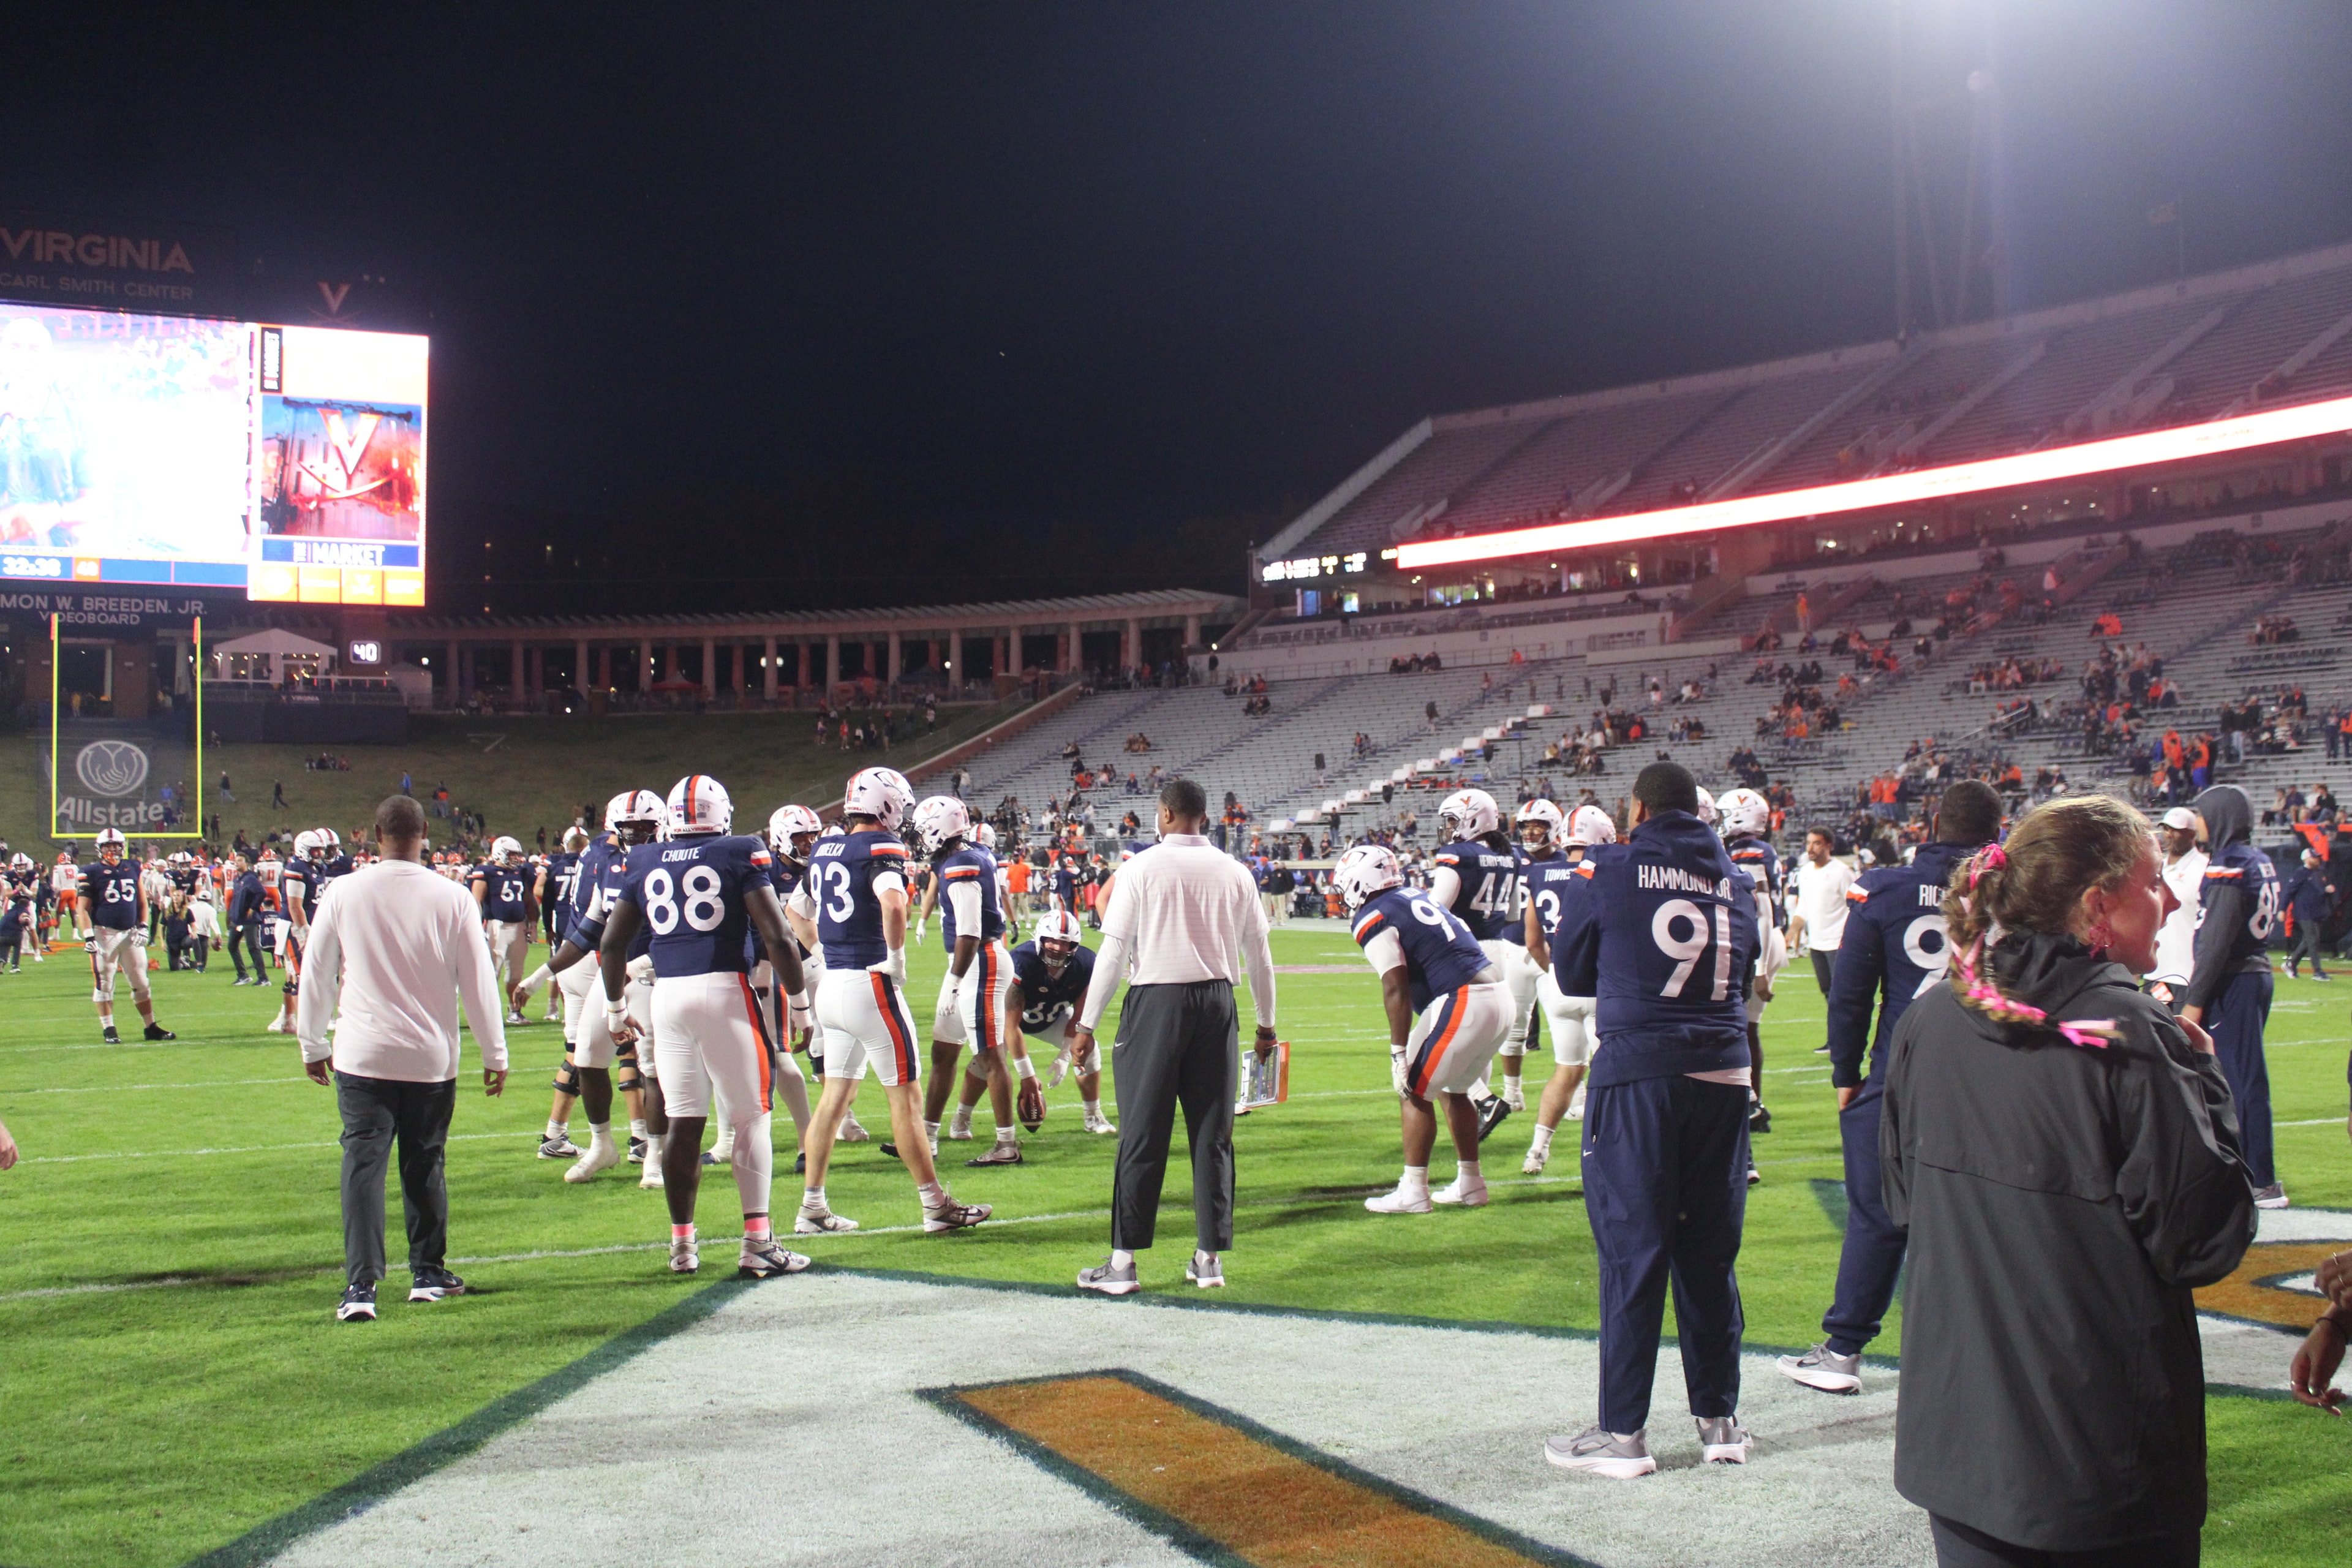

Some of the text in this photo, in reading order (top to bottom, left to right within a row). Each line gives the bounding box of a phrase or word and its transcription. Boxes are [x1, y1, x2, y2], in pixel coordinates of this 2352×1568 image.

[0, 226, 194, 274] VIRGINIA
[0, 273, 193, 300] CARL SMITH CENTER
[312, 543, 386, 567] MARKET
[55, 595, 74, 611] W.
[178, 600, 207, 615] JR.
[39, 610, 140, 625] VDEOBOARD
[353, 643, 377, 662] 40
[56, 796, 164, 827] Allstate
[661, 846, 703, 862] CHOUTE
[268, 869, 275, 881] 11
[1544, 868, 1576, 883] TOWNS
[1638, 864, 1734, 902] HAMMOND JR.
[104, 878, 136, 903] 65
[500, 880, 524, 902] 67
[644, 864, 726, 936] 88
[809, 861, 855, 925] 93
[1469, 872, 1515, 920] 44
[1918, 884, 1948, 907] RIC
[1651, 898, 1732, 1001] 91
